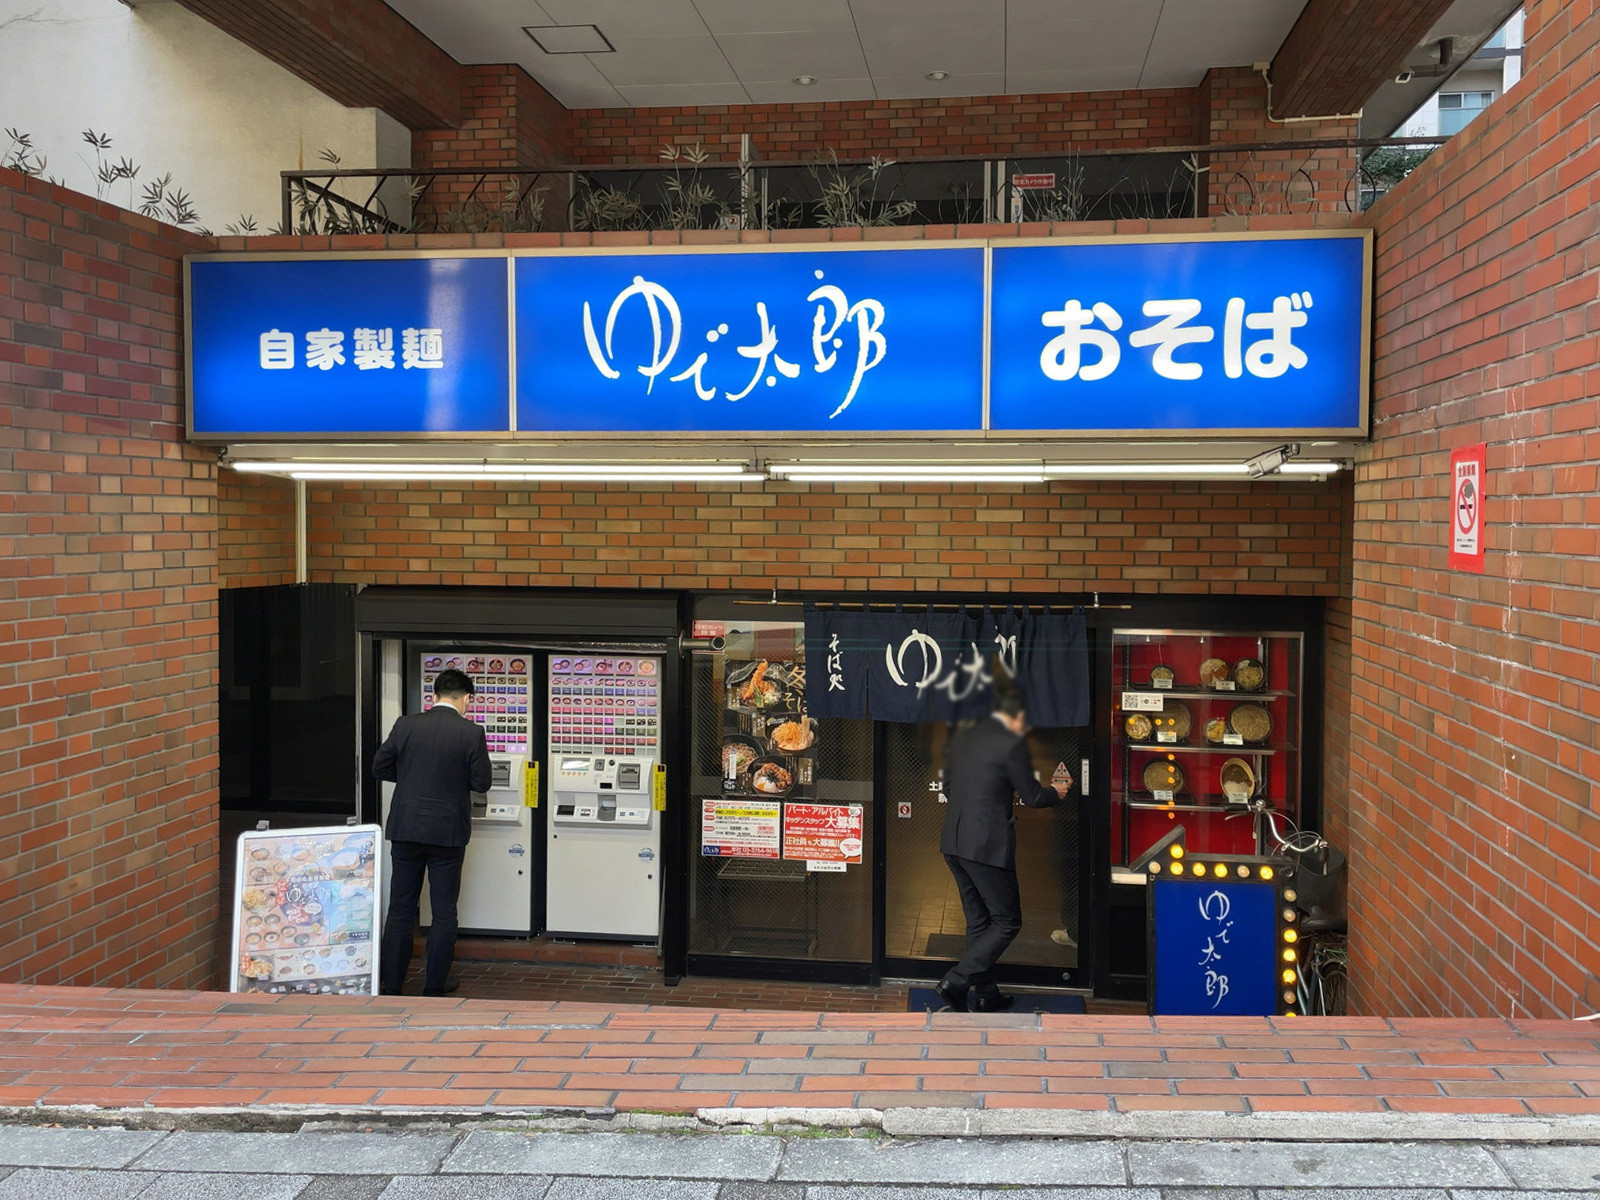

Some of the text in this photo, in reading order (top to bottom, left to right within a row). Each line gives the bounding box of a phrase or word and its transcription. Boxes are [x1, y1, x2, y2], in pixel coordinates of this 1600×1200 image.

[258, 327, 445, 371] 自家製麺
[582, 270, 887, 419] ゆで太郎
[1039, 291, 1314, 381] おそば
[827, 633, 845, 692] そば処
[1198, 890, 1234, 1010] ゆで太郎
